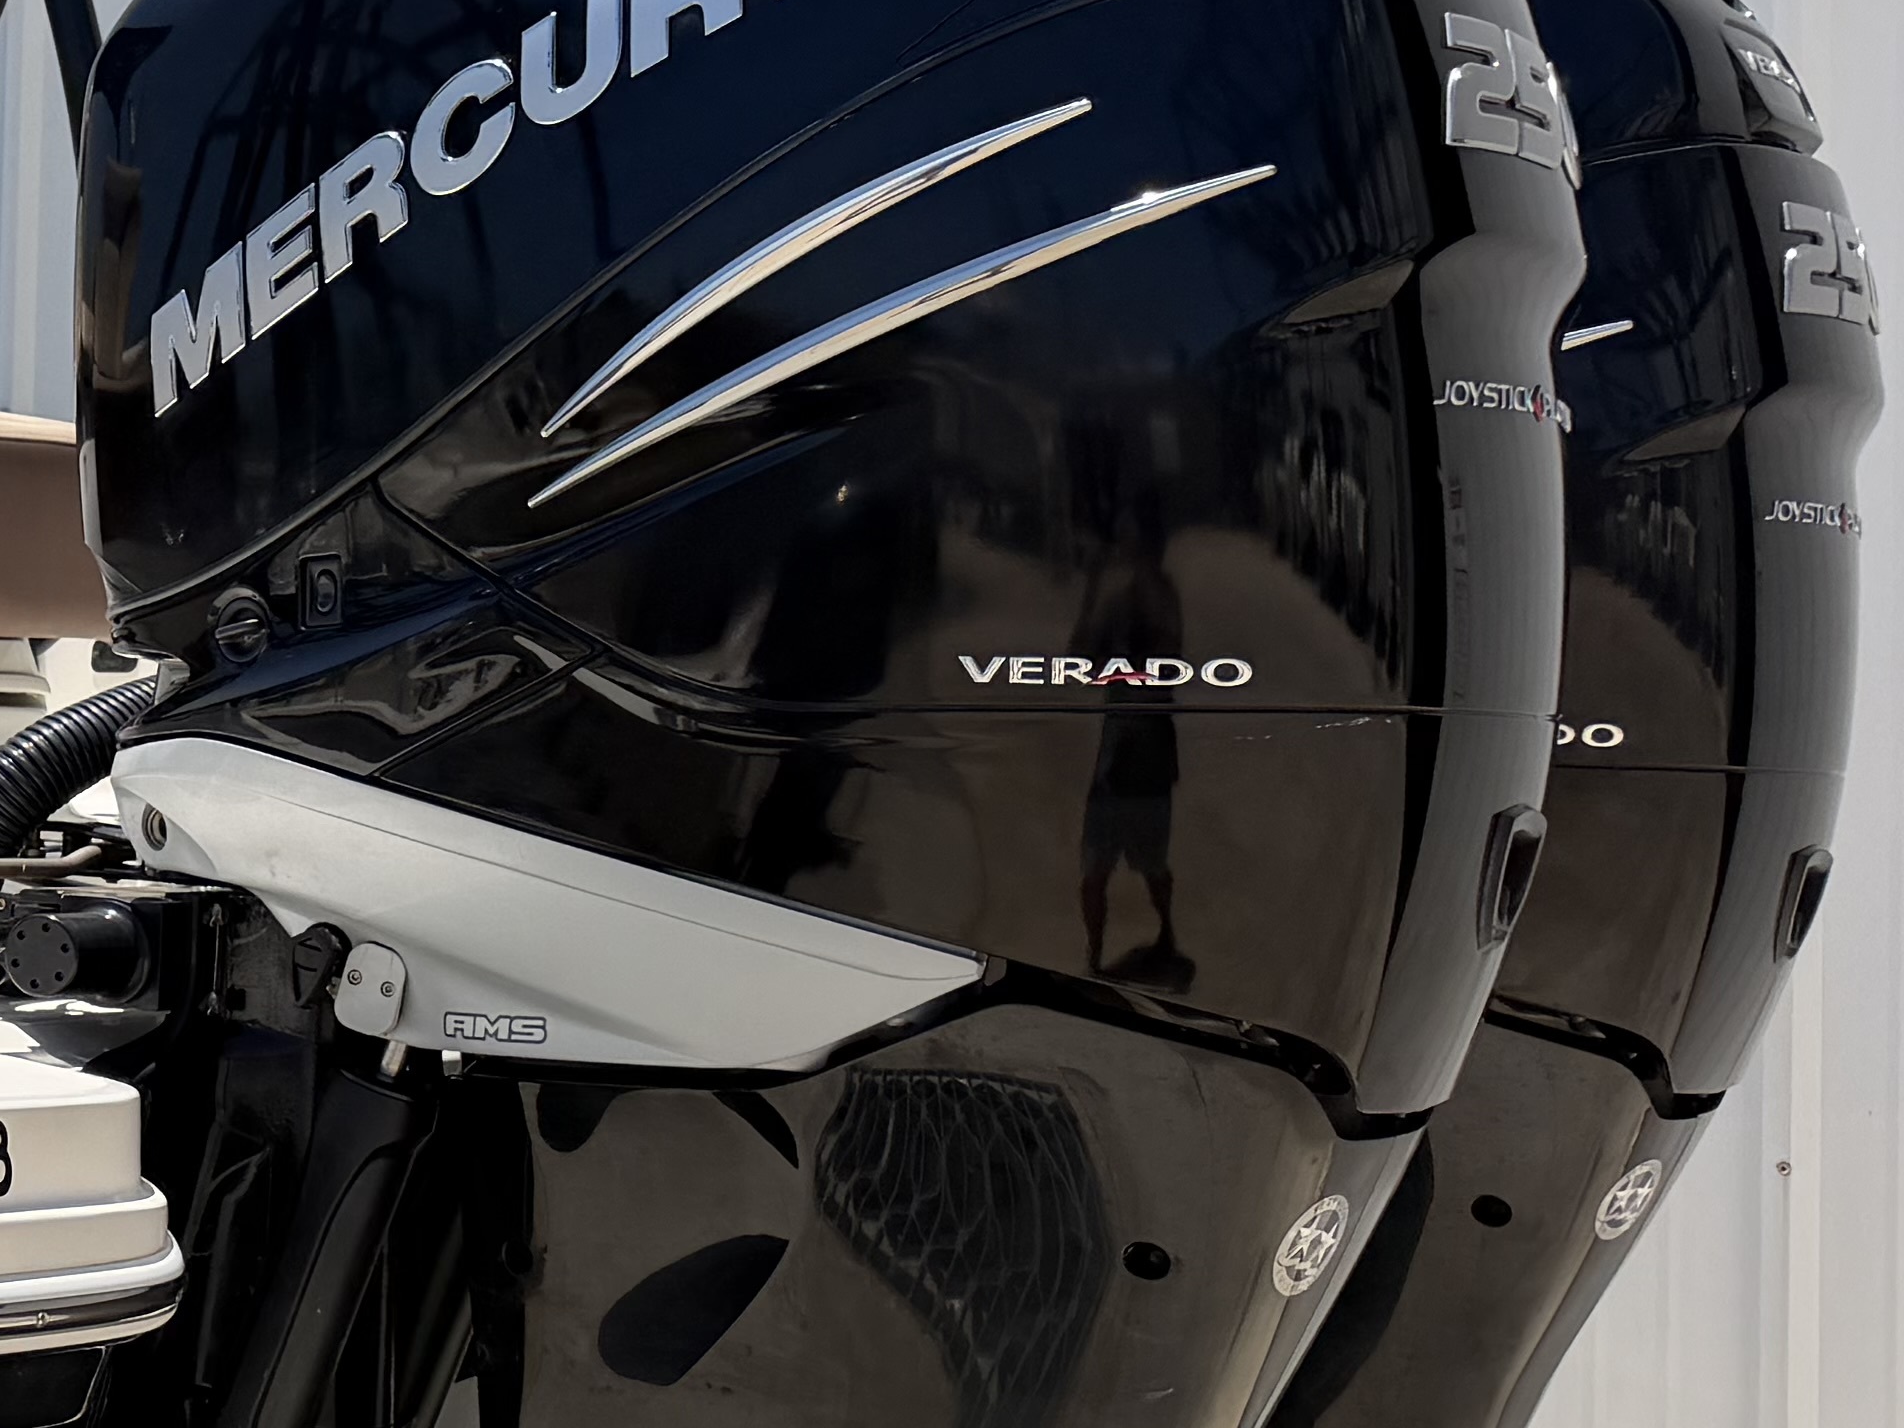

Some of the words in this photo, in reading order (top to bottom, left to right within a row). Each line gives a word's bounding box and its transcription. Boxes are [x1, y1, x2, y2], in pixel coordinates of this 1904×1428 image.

[1445, 12, 1583, 190] 25
[958, 656, 1252, 687] VERADO
[444, 1011, 547, 1044] AMS
